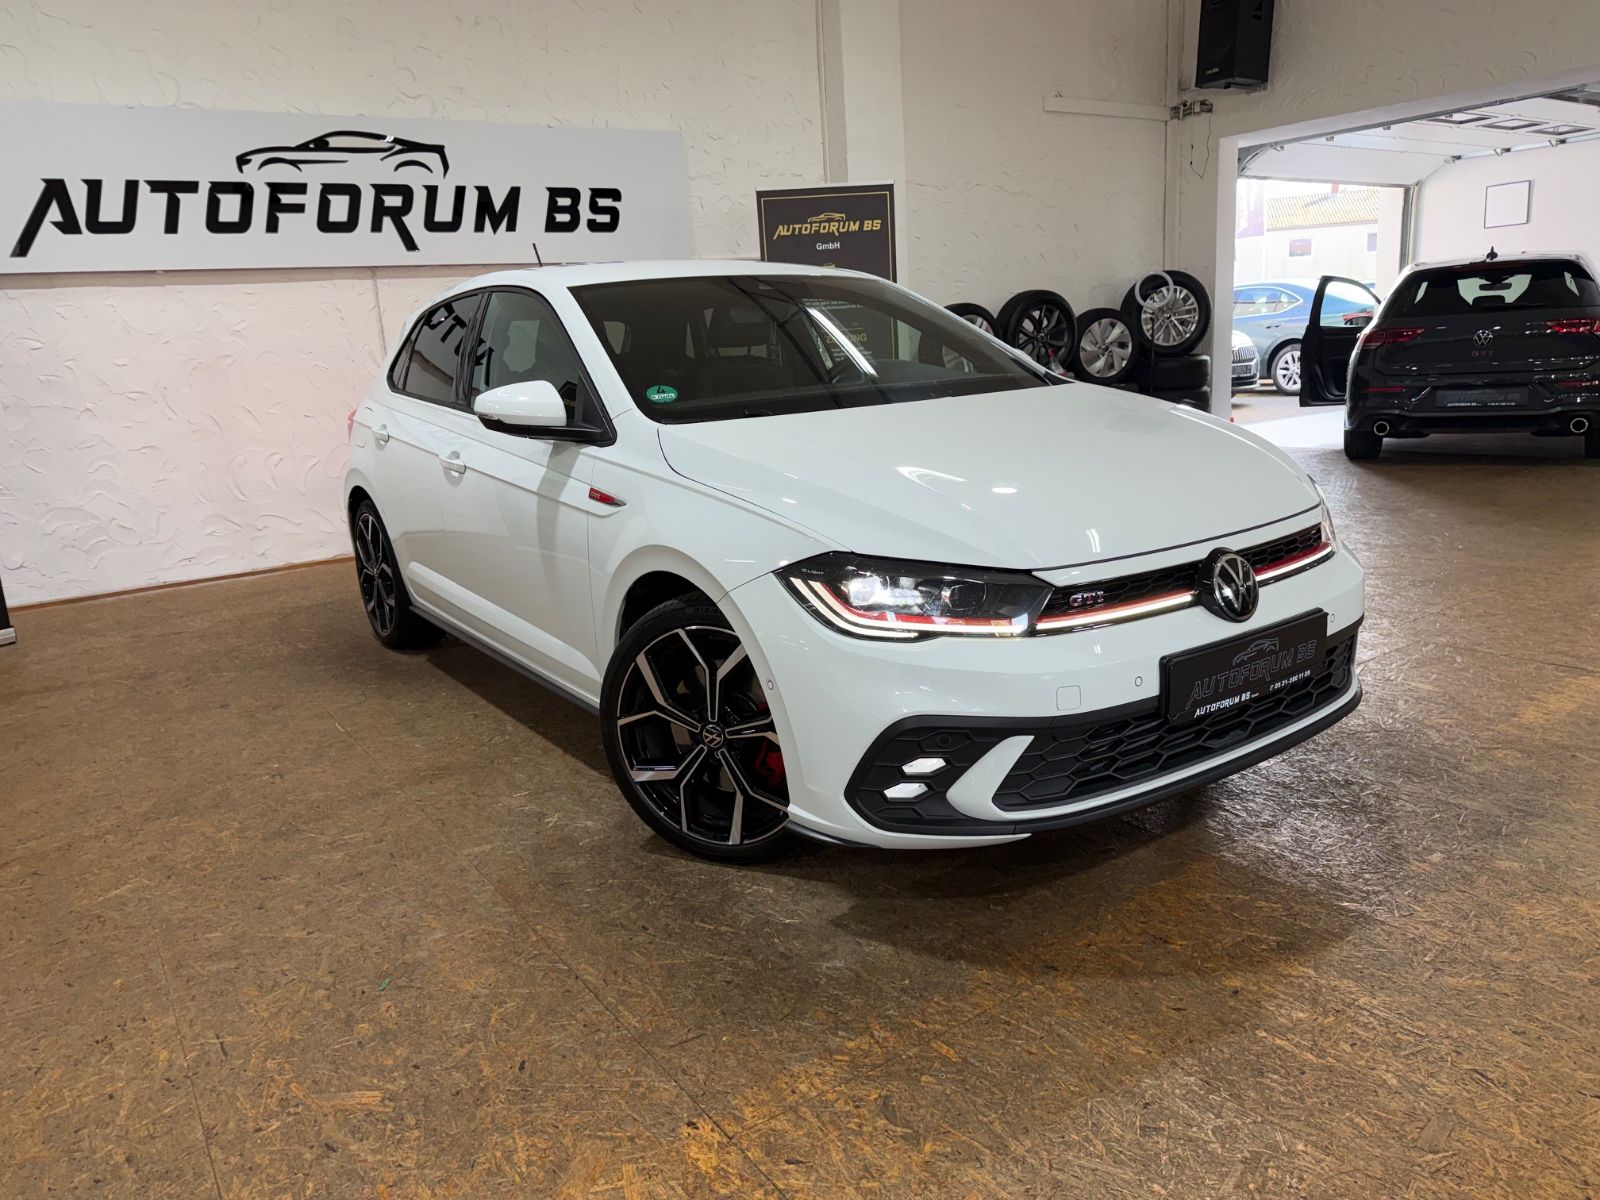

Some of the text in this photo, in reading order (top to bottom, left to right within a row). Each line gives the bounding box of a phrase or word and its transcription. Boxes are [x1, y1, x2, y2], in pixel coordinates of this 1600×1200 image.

[10, 177, 622, 258] AUTOFORUM BS
[773, 219, 881, 240] AUTOFORUM BS
[816, 241, 840, 251] GmbH
[656, 385, 666, 394] 4
[1069, 591, 1104, 607] GTI
[1185, 639, 1317, 710] AUTOFORUM BS
[1194, 691, 1251, 718] AUTOFORUM BS
